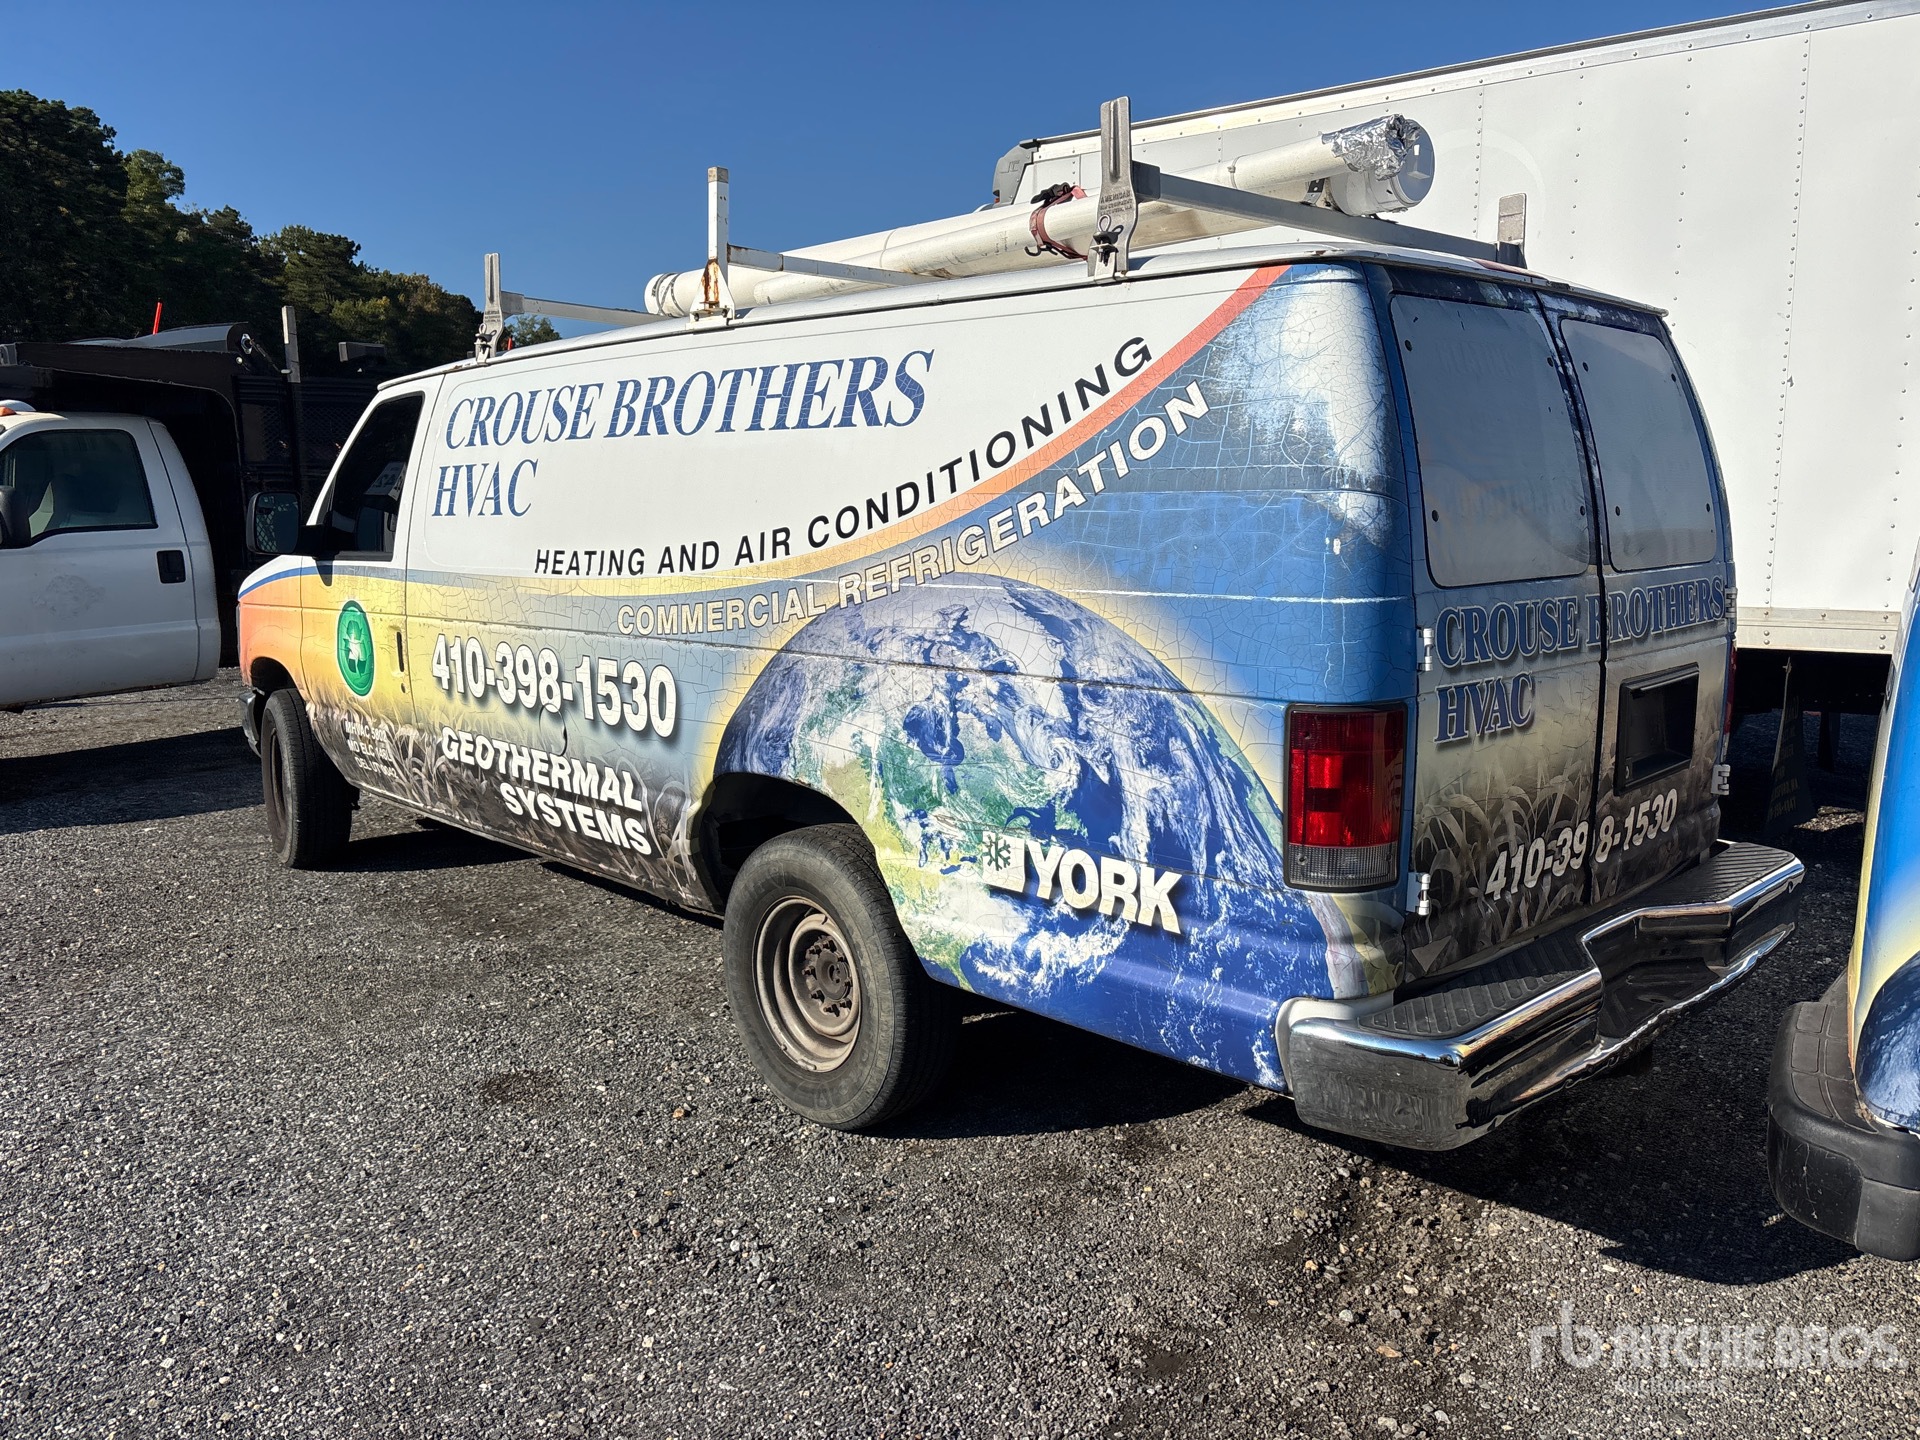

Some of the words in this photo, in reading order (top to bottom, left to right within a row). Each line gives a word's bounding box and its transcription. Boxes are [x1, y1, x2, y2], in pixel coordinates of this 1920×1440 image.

[445, 381, 604, 450] CROUSE
[603, 348, 935, 439] BROTHERS
[430, 457, 540, 518] HVAC
[534, 547, 647, 577] HEATING
[657, 540, 721, 575] AND
[734, 526, 793, 566] AIR
[806, 336, 1154, 549] CONDITIONING
[616, 581, 829, 636] COMMERCIAL
[838, 380, 1212, 611] REFRIGERATION
[1434, 595, 1581, 669] CROUSE
[1585, 574, 1726, 648] BROTHERS
[431, 633, 678, 739] 410-398-1530
[1433, 670, 1537, 746] HVAC
[347, 739, 360, 753] MD
[440, 725, 645, 813] GEOTHERMAL
[499, 781, 652, 856] SYSTEMS
[1484, 788, 1679, 901] 410-398-1530
[1026, 839, 1184, 935] YORK
